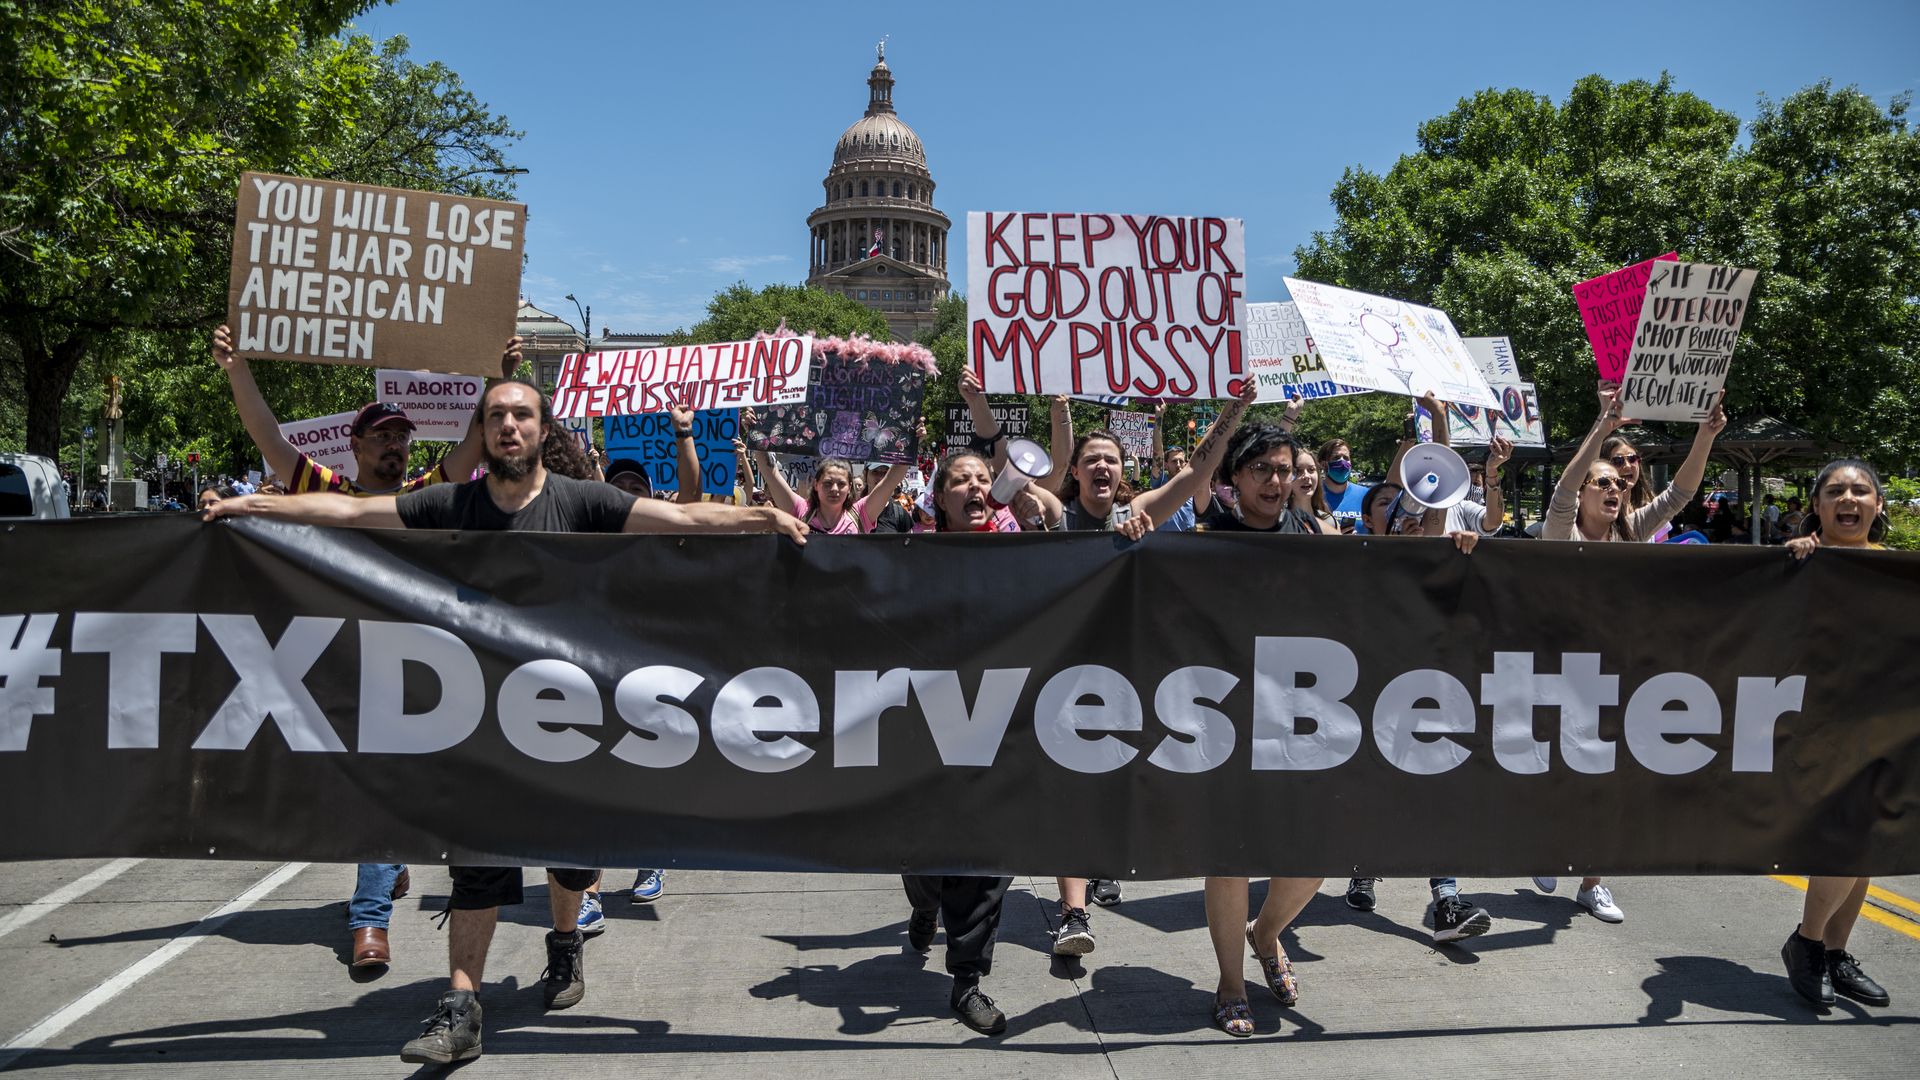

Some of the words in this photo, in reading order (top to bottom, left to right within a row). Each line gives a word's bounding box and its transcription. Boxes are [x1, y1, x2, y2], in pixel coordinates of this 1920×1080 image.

[253, 178, 323, 225] YOU
[332, 188, 411, 236] WILL
[426, 201, 516, 250] LOSE
[247, 222, 318, 268] THE
[328, 231, 412, 278] WAR
[423, 243, 474, 285] ON
[985, 212, 1115, 268] KEEP
[1121, 214, 1237, 273] YOUR
[1607, 265, 1650, 296] GIRLS
[1671, 264, 1693, 289] IF
[1707, 267, 1743, 292] MY
[239, 266, 445, 325] AMERICAN
[988, 262, 1091, 321] GOD
[1099, 265, 1182, 323] OUT
[1196, 271, 1243, 326] OF
[1588, 300, 1621, 328] JUST
[1653, 296, 1742, 326] UTERUS
[239, 312, 375, 360] WOMEN
[1637, 321, 1688, 349] SHOT
[561, 352, 596, 388] HE
[598, 350, 657, 385] WHO
[665, 341, 750, 382] HATH
[751, 338, 803, 379] NO
[973, 317, 1057, 394] MY
[1069, 321, 1243, 398] PUSSY!
[1491, 339, 1512, 375] THANK
[1632, 353, 1665, 373] YOU
[384, 381, 402, 396] EL
[406, 381, 477, 397] ABORTO
[552, 382, 663, 418] UTERUS
[662, 378, 729, 412] SHUT
[812, 386, 892, 412] RIGHTS
[1283, 380, 1337, 400] DISABLED
[1624, 377, 1698, 408] REGULATE
[436, 402, 448, 411] DE
[449, 402, 477, 411] SALUD
[950, 409, 959, 420] IF
[961, 409, 973, 420] ME
[1009, 408, 1027, 421] GET
[288, 423, 353, 447] ABORTO
[411, 419, 460, 429] osiesLaw.org
[609, 415, 704, 441] ABORO
[707, 417, 737, 442] NO
[1006, 421, 1028, 434] THEY
[1110, 417, 1148, 431] SEXISM
[318, 447, 330, 457] DE
[331, 443, 353, 455] SALU
[946, 435, 972, 446] WOULD
[699, 462, 728, 488] YO
[0, 612, 1807, 776] #TXDeservesBetter
